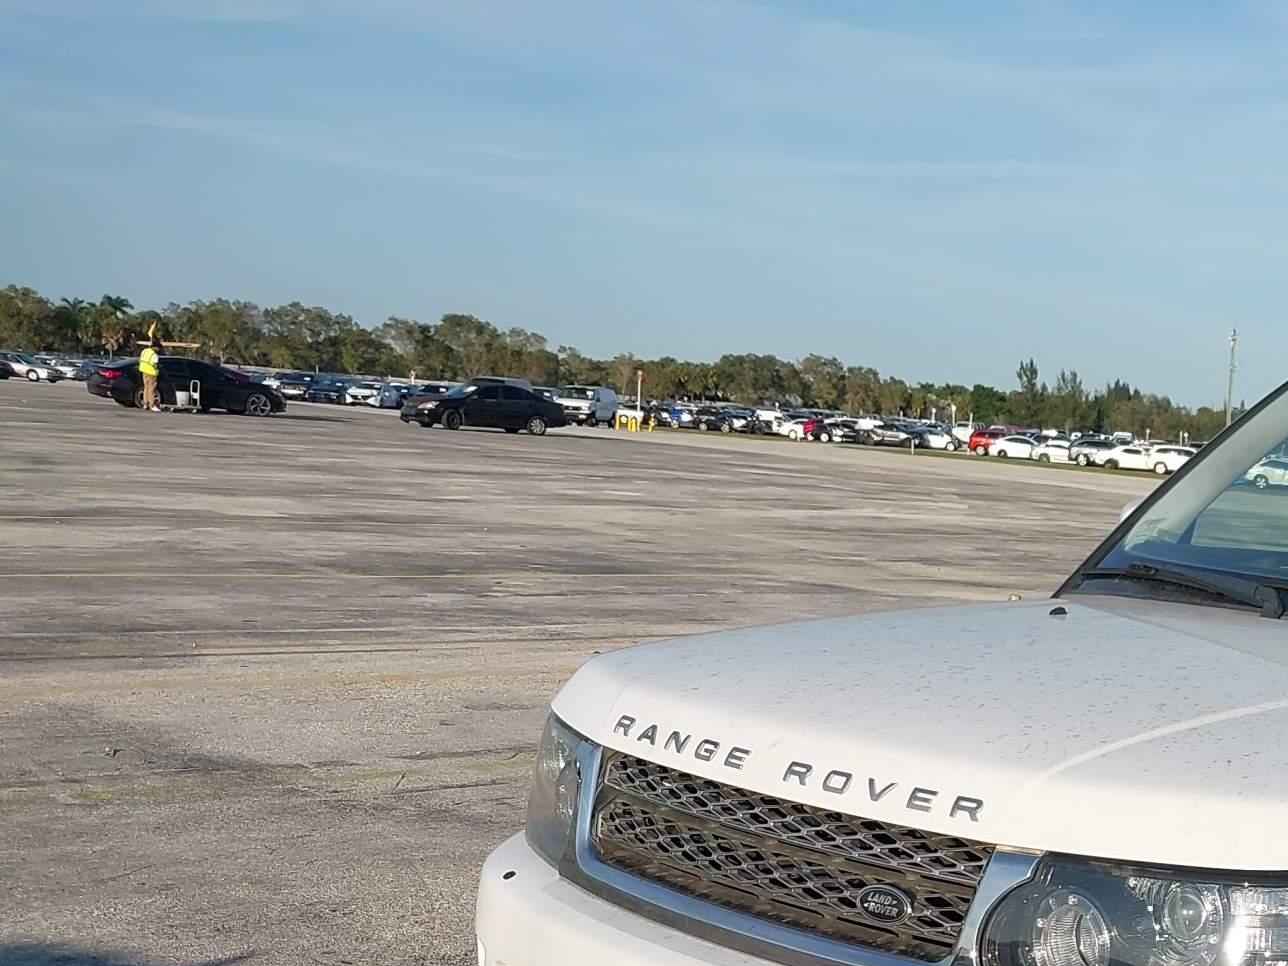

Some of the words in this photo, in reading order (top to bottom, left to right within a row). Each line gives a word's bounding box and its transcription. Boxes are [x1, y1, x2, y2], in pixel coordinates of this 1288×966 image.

[612, 713, 752, 770] RANGE
[782, 760, 985, 823] ROVER
[867, 892, 893, 905] LAND
[868, 903, 899, 918] ROVER
